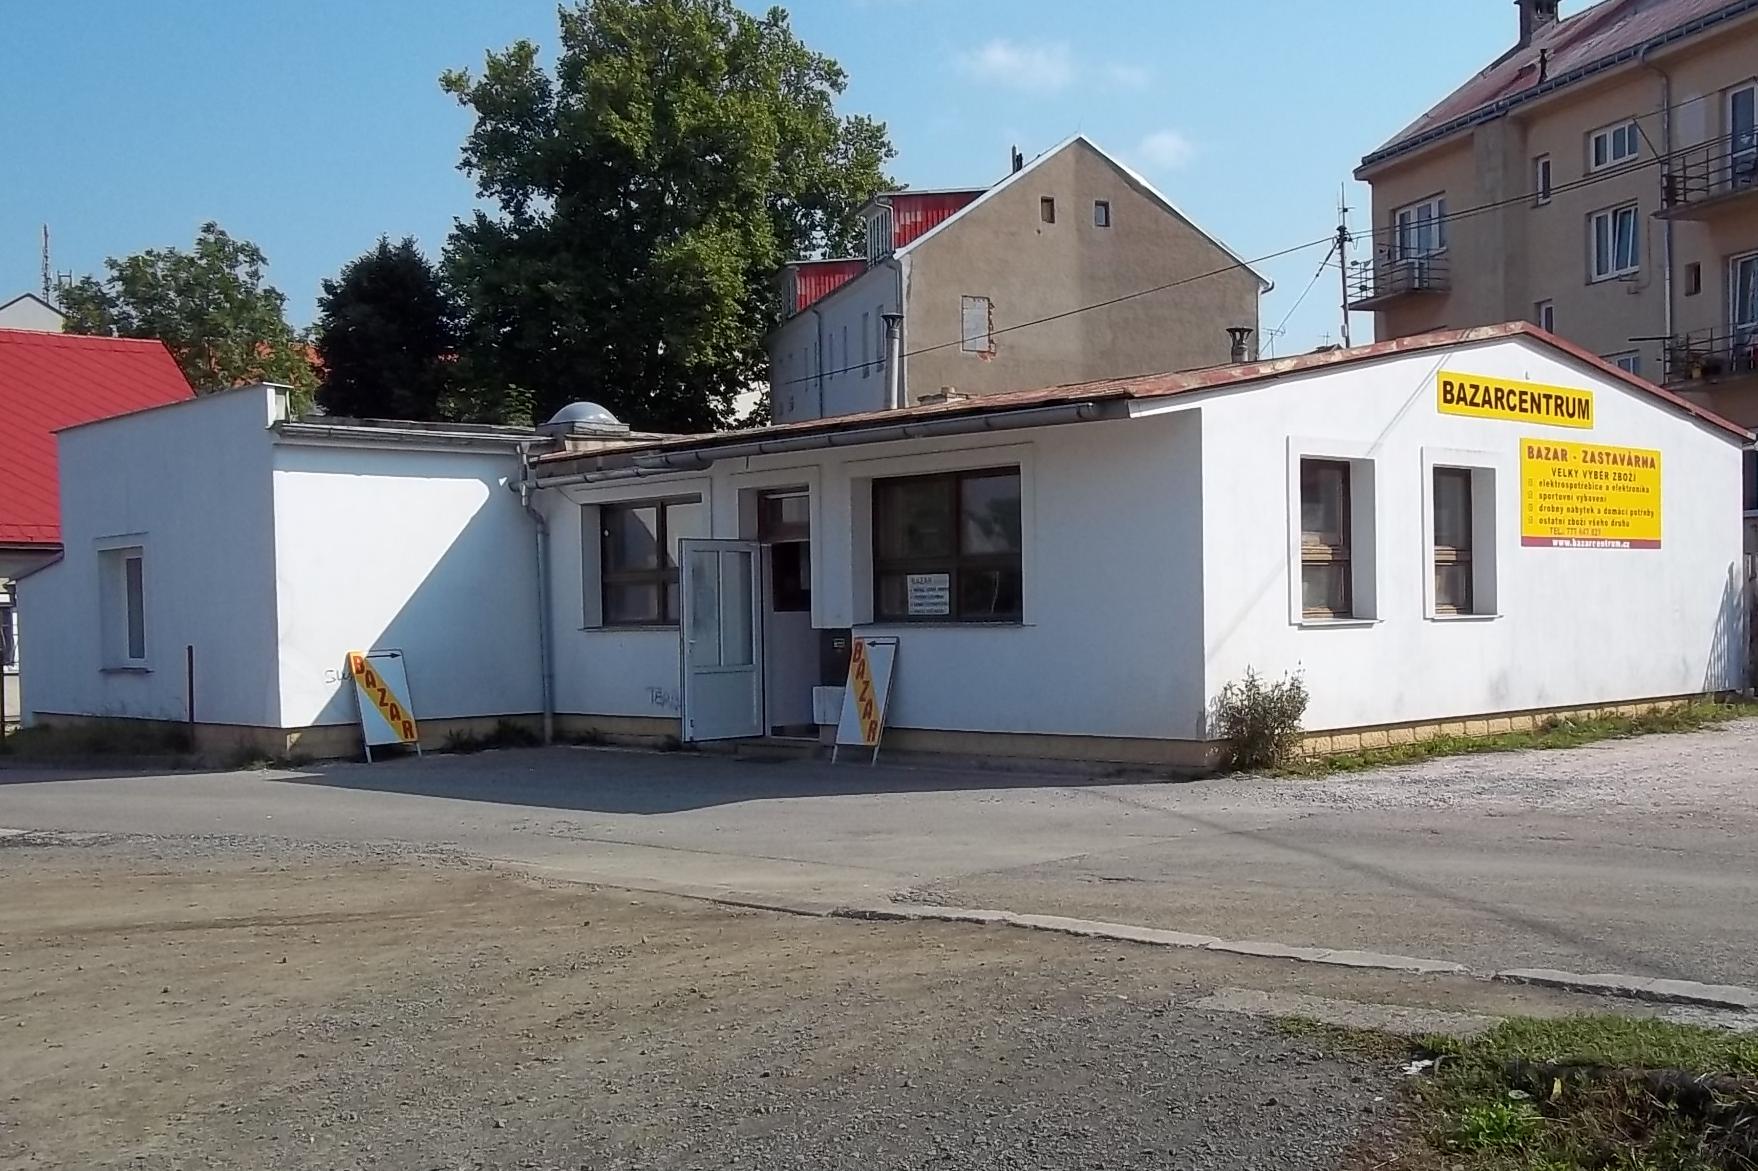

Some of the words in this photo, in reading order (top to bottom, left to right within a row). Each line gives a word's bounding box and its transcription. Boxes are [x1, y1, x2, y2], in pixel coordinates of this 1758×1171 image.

[1442, 380, 1590, 421] BAZARCENTRUM
[1527, 445, 1568, 462] BAZAR
[1582, 450, 1656, 470] ZASTAVÁRNA
[1551, 538, 1630, 548] www.bazarcentrum.cz
[352, 655, 415, 739] BAZAR
[853, 641, 878, 742] BAZAR
